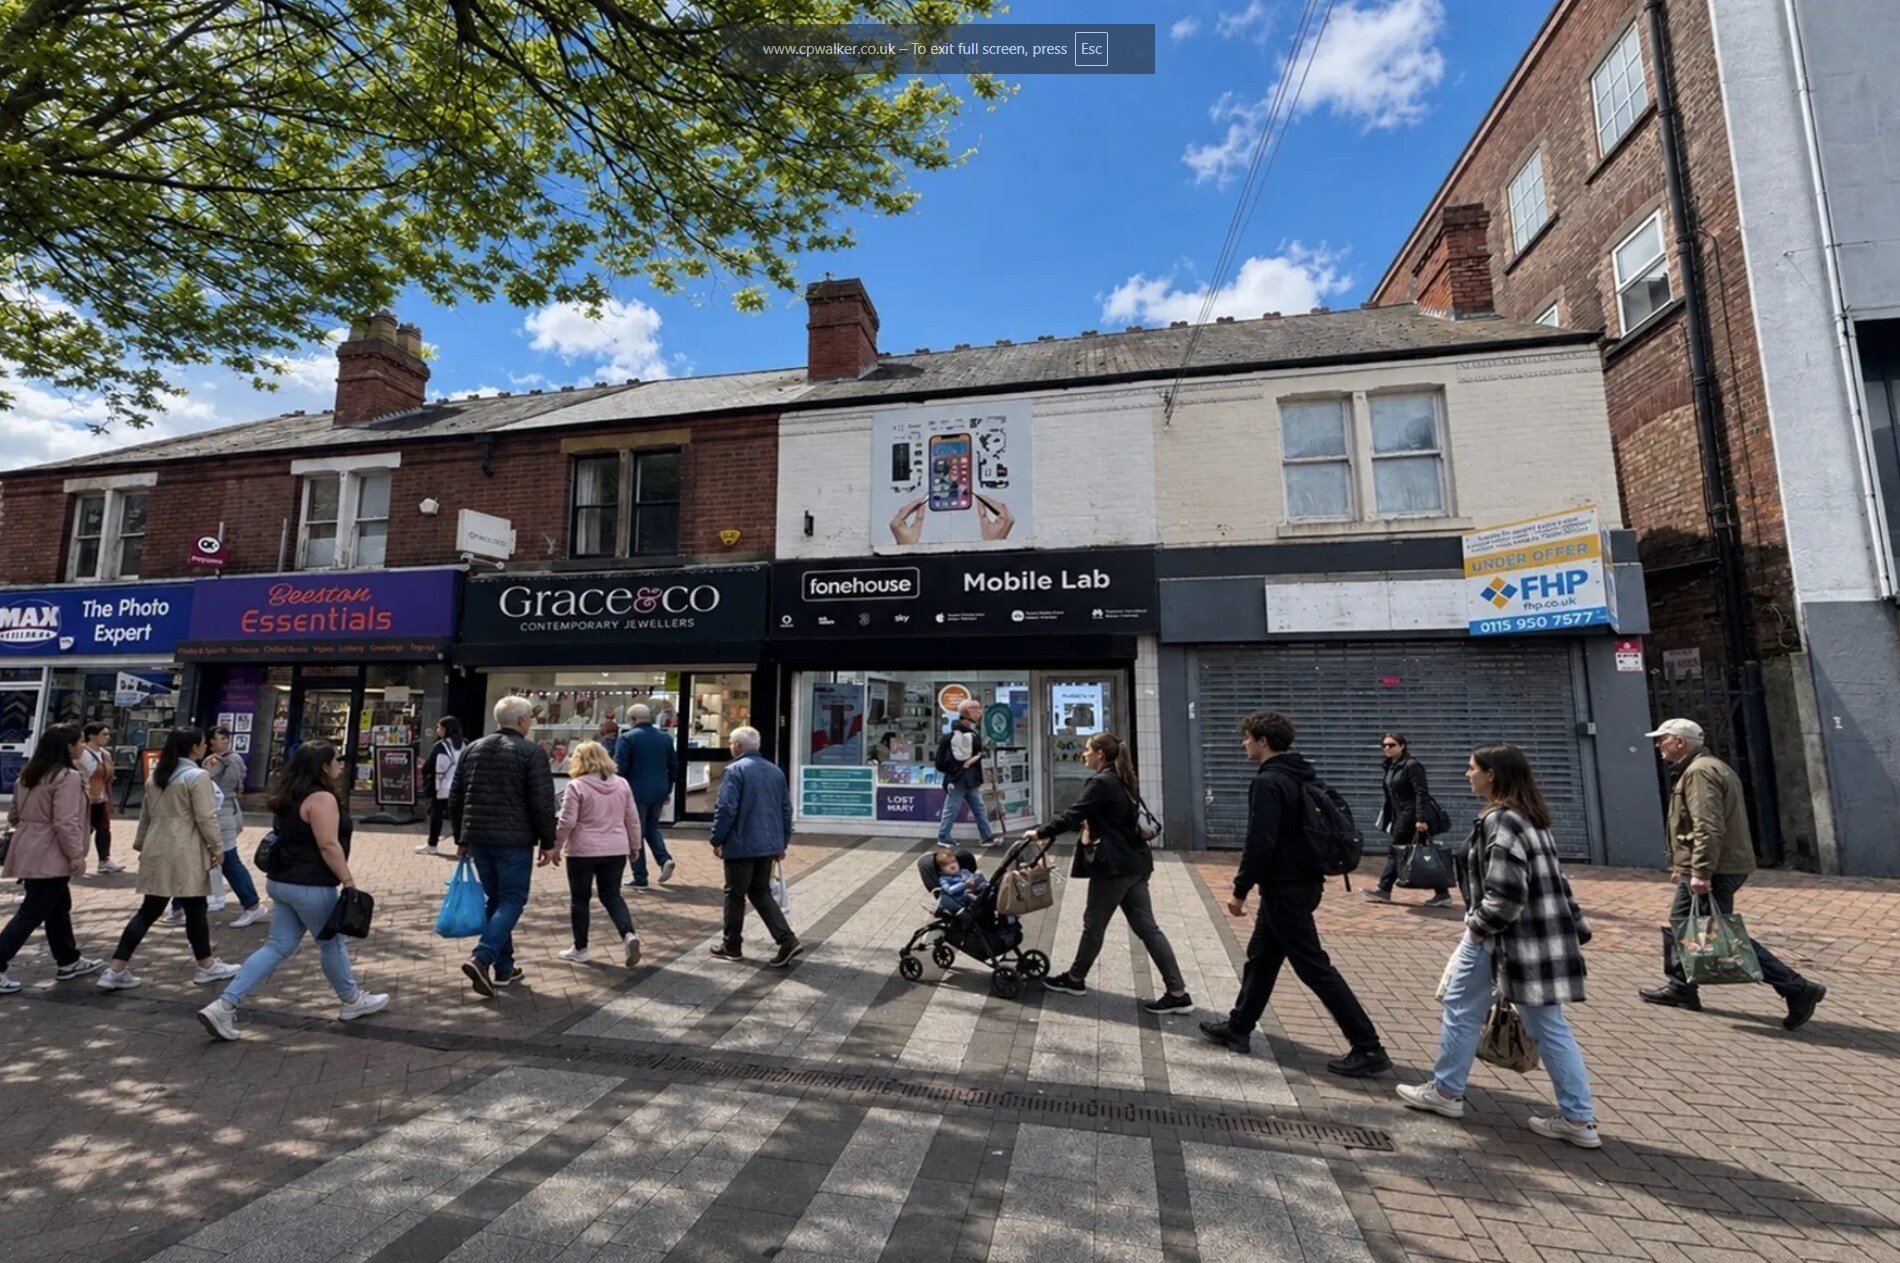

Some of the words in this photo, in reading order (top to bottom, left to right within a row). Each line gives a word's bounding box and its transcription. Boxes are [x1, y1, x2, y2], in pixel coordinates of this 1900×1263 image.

[1472, 551, 1526, 572] UNDER
[1532, 543, 1590, 562] OFFER
[809, 576, 912, 595] fonehouse
[963, 570, 1053, 592] Mobile
[1061, 569, 1111, 590] Lab
[1520, 569, 1589, 600] FHP
[268, 583, 373, 607] Beeston
[1523, 596, 1577, 611] fhp.co.uk
[0, 606, 60, 628] MAX
[82, 600, 113, 618] The
[118, 598, 170, 617] Photo
[241, 605, 392, 633] Essentials
[894, 613, 910, 623] sky
[520, 620, 619, 632] CONTEMPORARY
[623, 618, 695, 630] JEWELLERS
[1480, 618, 1512, 633] 0115
[1516, 615, 1548, 631] 950
[1552, 611, 1593, 626] 7577
[94, 623, 152, 647] Expert
[887, 795, 915, 804] LOST
